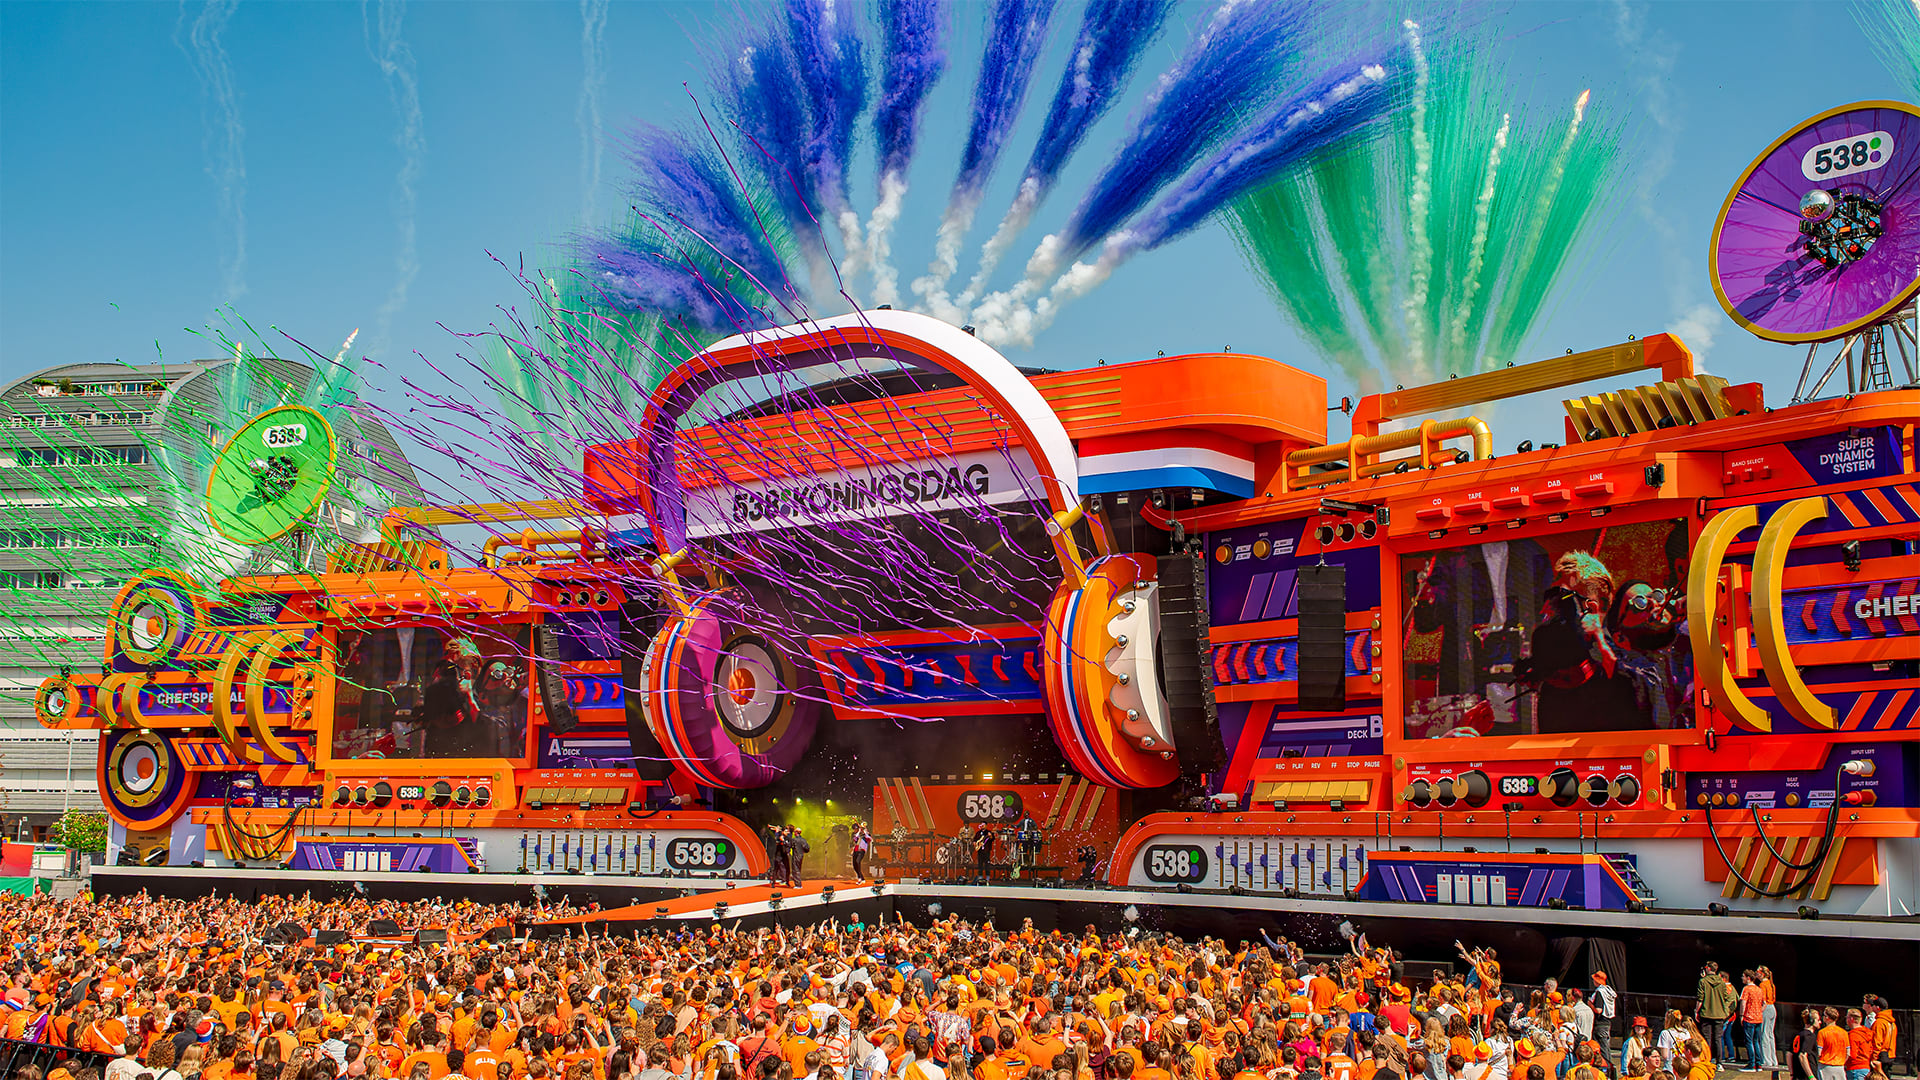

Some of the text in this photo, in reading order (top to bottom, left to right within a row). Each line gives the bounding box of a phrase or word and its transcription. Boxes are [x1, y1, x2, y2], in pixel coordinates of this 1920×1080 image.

[1814, 140, 1869, 175] 538
[269, 427, 295, 444] 538
[1838, 436, 1875, 451] SUPER
[1819, 448, 1875, 465] DYNAMIC
[1833, 459, 1875, 475] SYSTEM
[1547, 479, 1561, 488] DAB
[1589, 473, 1604, 481] LINE
[793, 463, 989, 517] KONINGSDAG
[1468, 492, 1482, 500] TAPE
[1510, 486, 1519, 494] FM
[156, 691, 245, 704] CHEF'SPEAL
[1347, 715, 1383, 739] DECK B
[547, 738, 581, 756] A DECK
[400, 787, 419, 798] 538
[1502, 778, 1529, 794] 538
[965, 794, 1004, 819] 538
[674, 842, 716, 865] 538
[1151, 850, 1190, 878] 538
